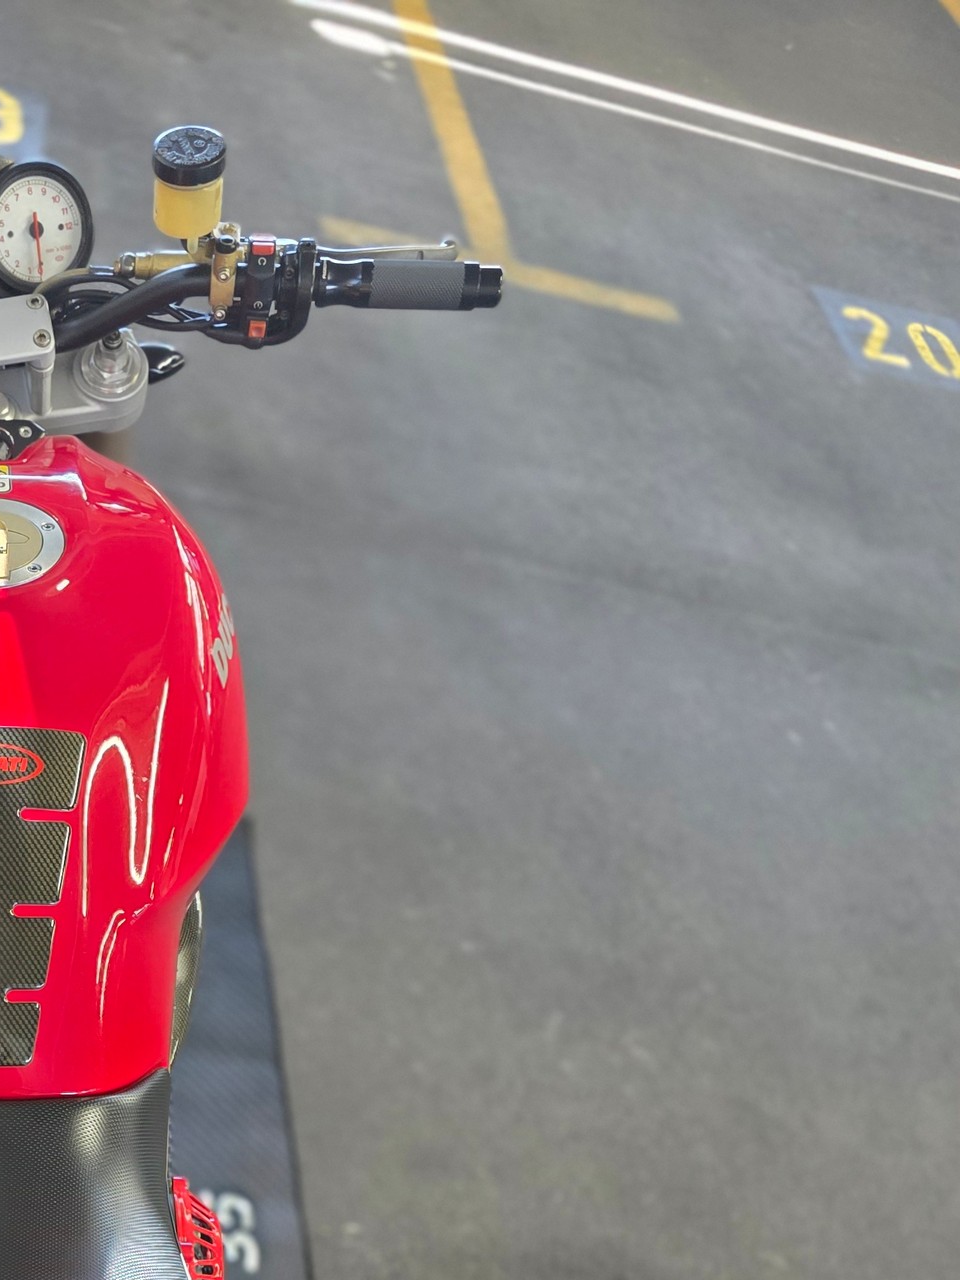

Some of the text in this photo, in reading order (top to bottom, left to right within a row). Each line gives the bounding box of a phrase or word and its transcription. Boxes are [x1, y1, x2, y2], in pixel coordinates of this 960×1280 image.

[27, 187, 33, 195] 8
[41, 187, 47, 196] 9
[52, 195, 61, 203] 10
[61, 207, 68, 215] 11
[65, 222, 73, 230] 12
[842, 306, 960, 380] 20
